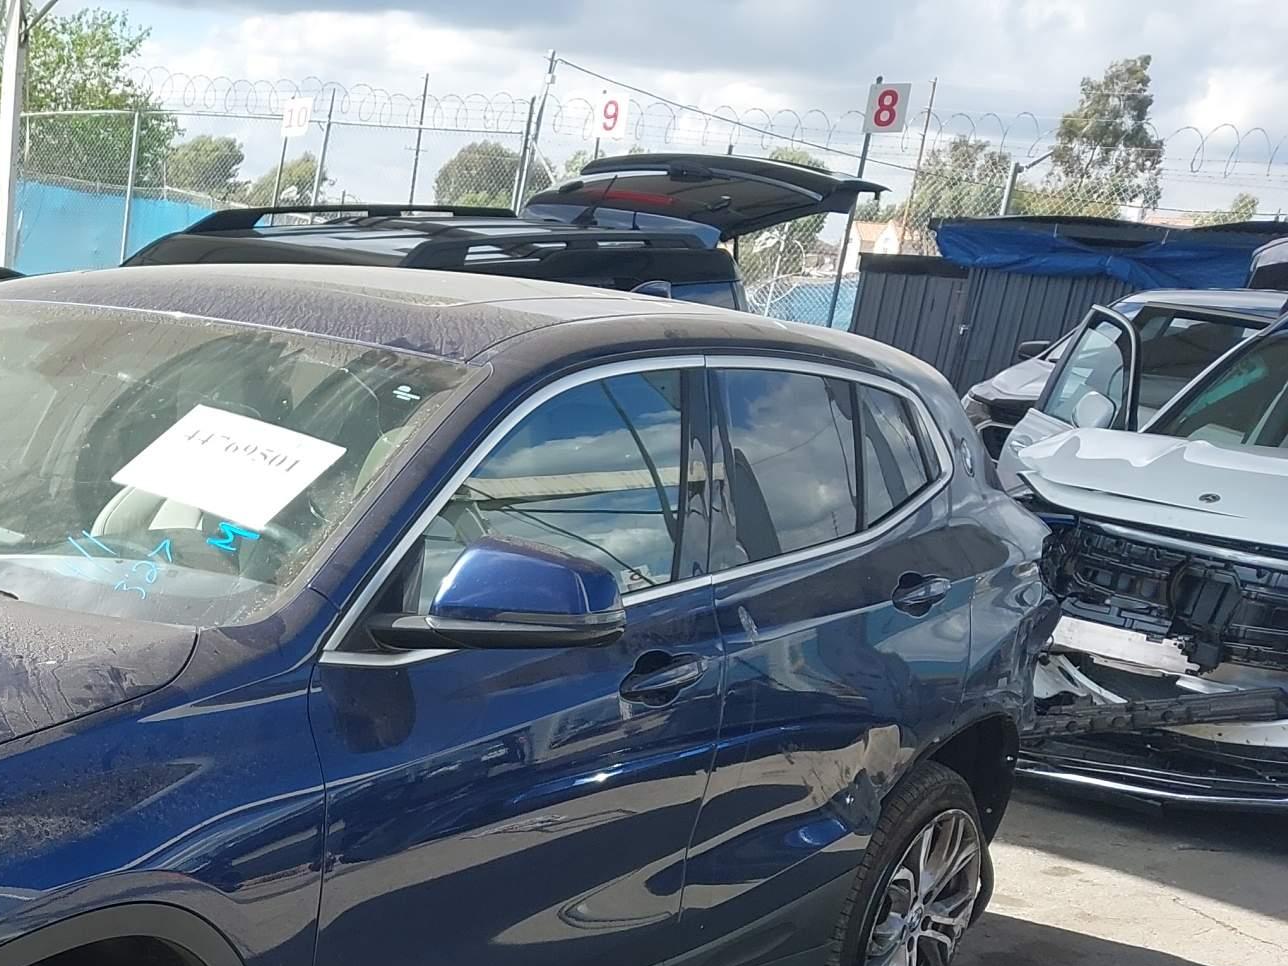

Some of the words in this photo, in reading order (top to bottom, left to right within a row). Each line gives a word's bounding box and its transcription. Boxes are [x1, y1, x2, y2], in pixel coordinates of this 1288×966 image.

[284, 106, 309, 129] 10
[602, 99, 619, 131] 9
[874, 89, 899, 127] 8
[184, 429, 301, 473] 44769501
